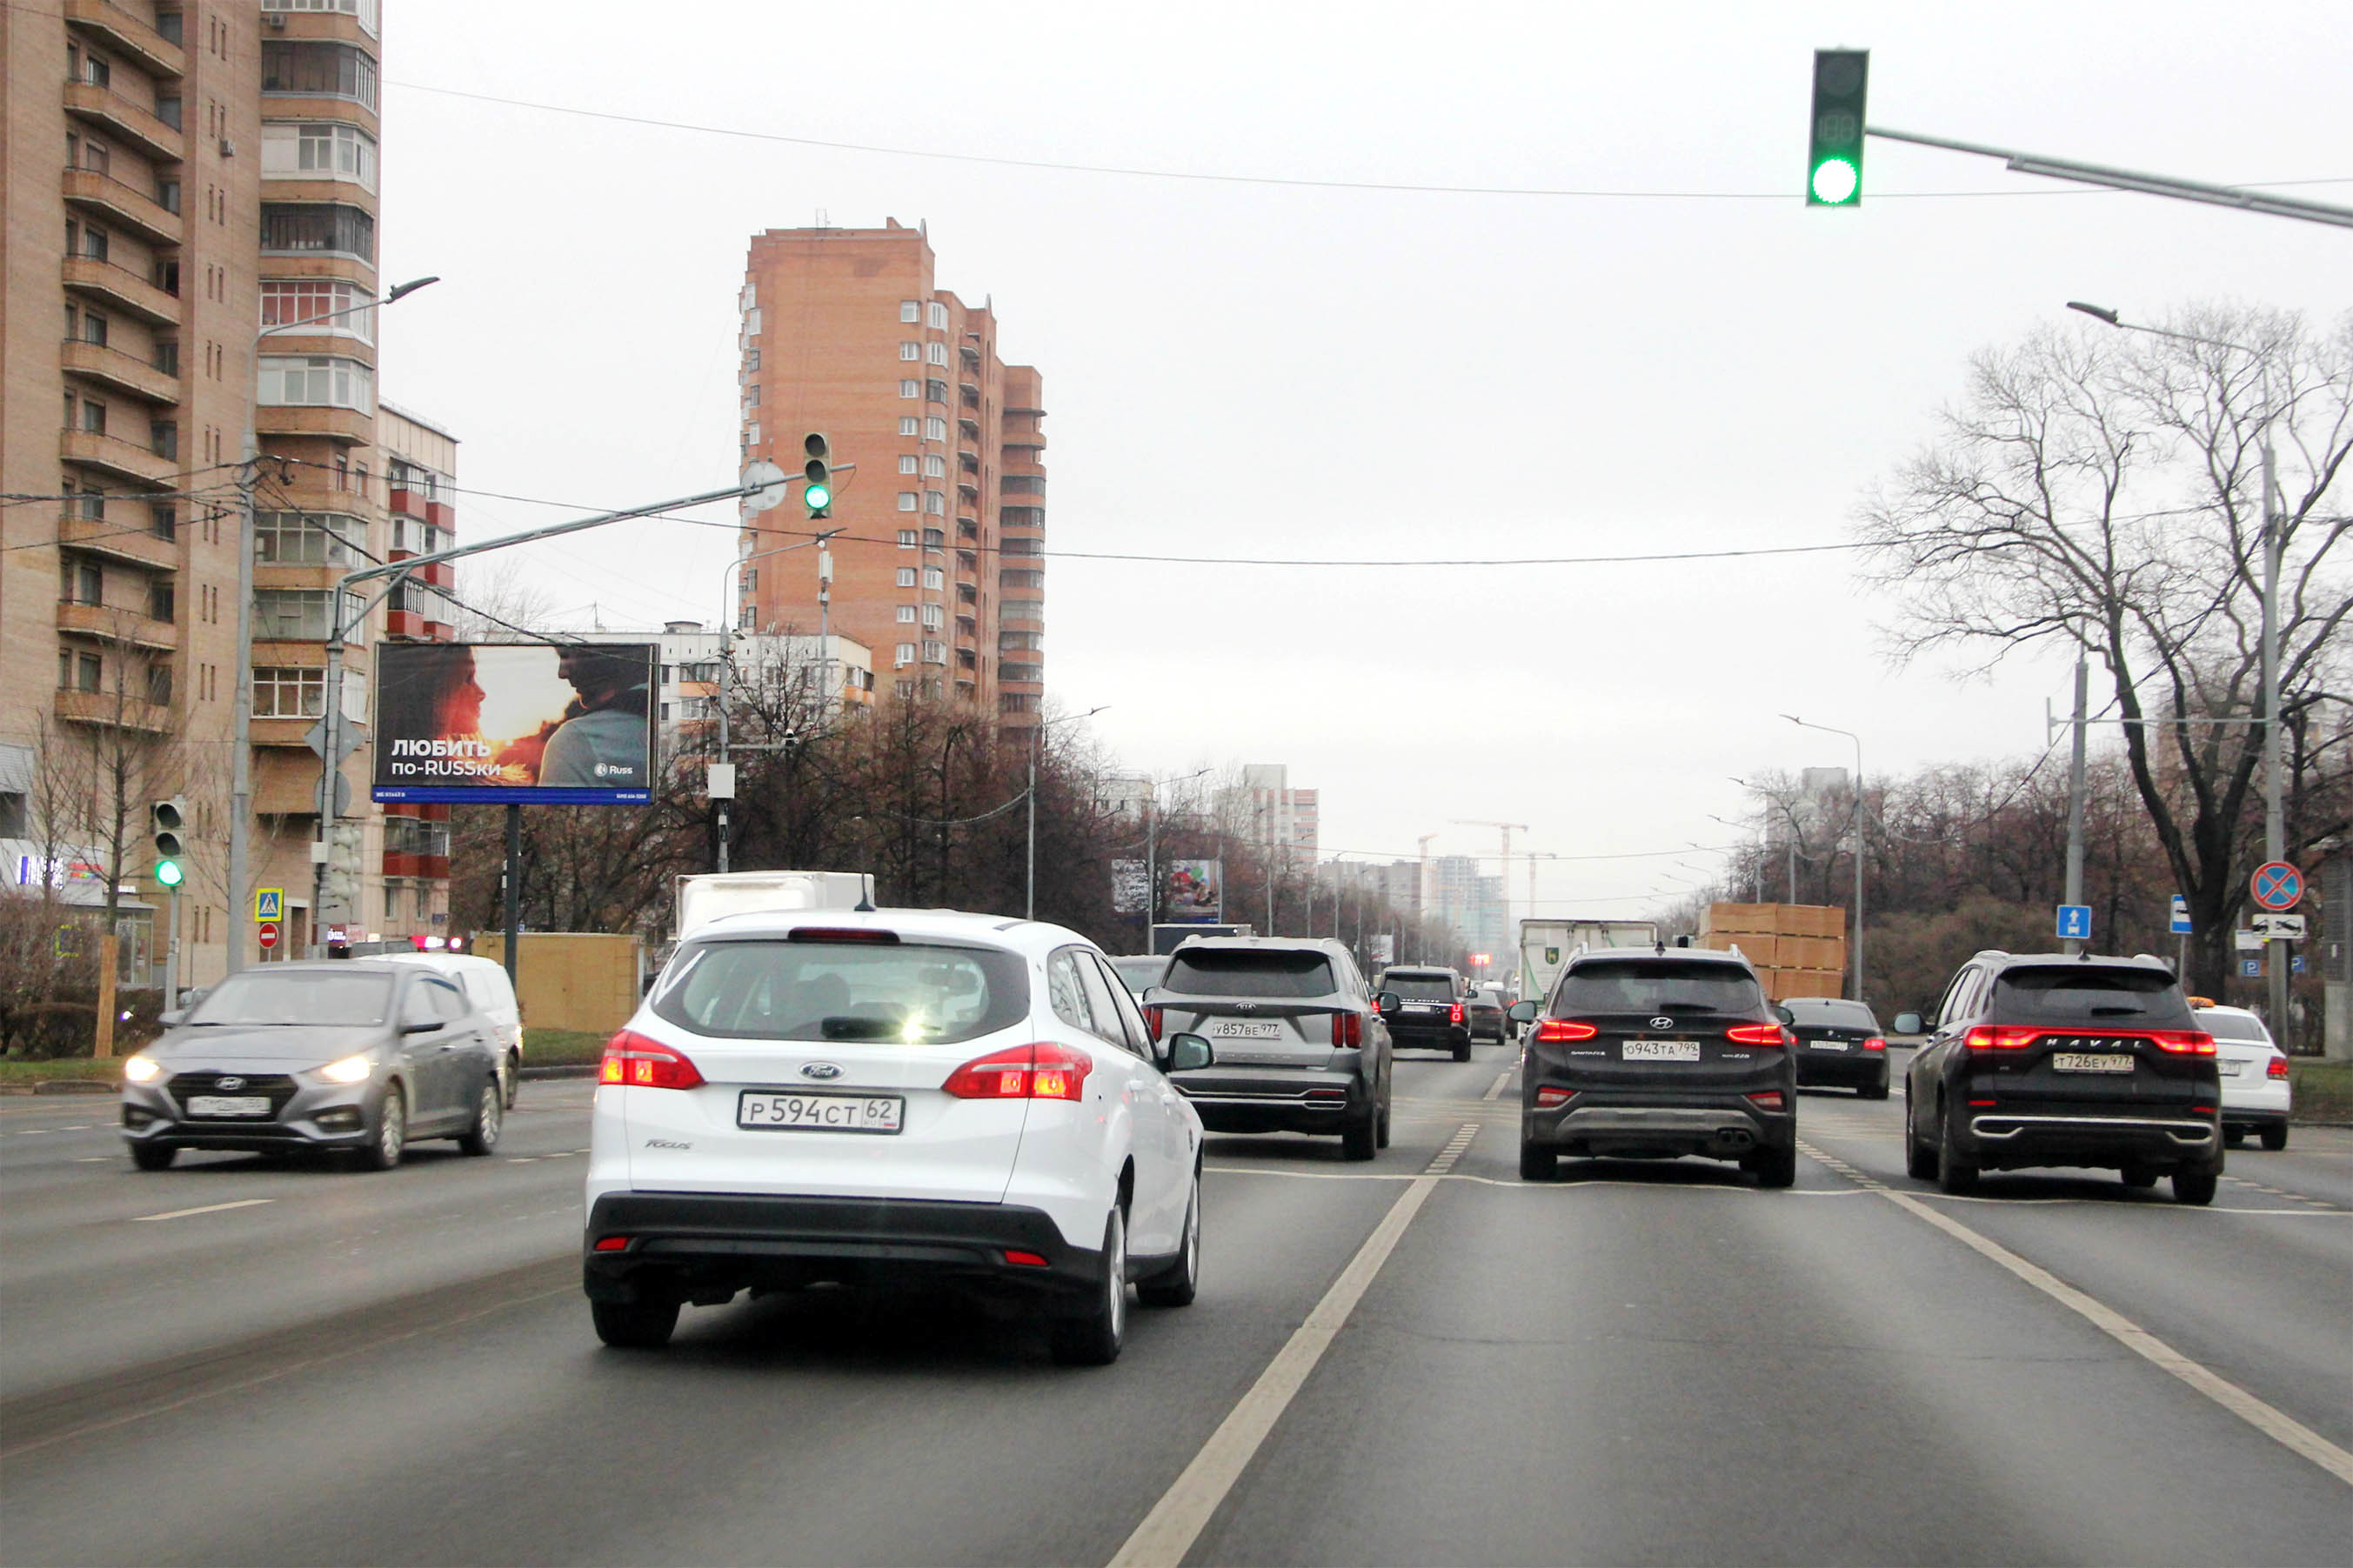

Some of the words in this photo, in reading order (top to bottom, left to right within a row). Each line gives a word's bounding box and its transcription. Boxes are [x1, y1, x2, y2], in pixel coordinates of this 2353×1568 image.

[391, 739, 491, 757] ЛЮБИТЬ
[391, 760, 501, 776] по-RUSSки
[609, 765, 633, 774] Russ
[2046, 1038, 2142, 1048] HAVAL
[866, 1099, 892, 1118] 62
